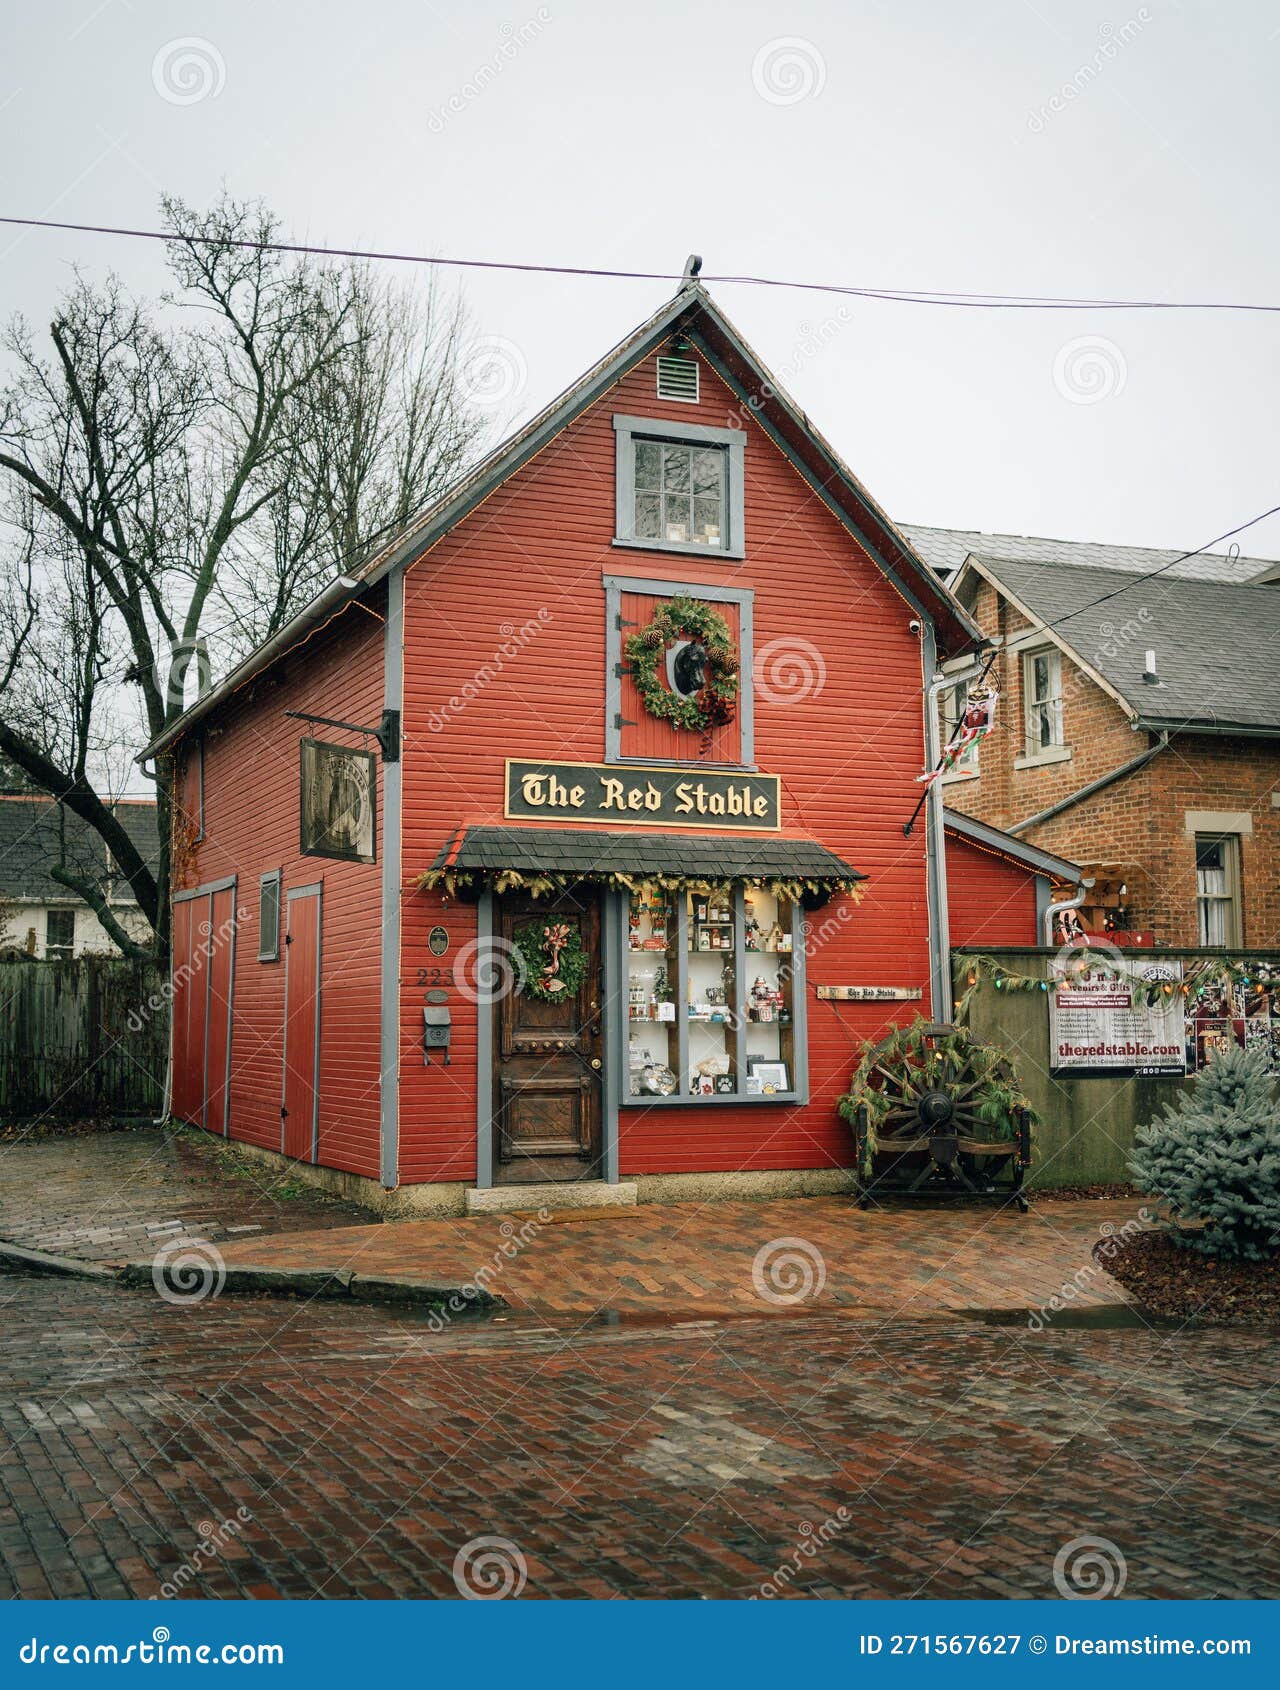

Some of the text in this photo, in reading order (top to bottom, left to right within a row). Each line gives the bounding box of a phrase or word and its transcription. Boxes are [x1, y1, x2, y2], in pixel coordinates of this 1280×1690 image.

[521, 773, 768, 818] The Red Stable
[1058, 1041, 1181, 1057] theredstable.com
